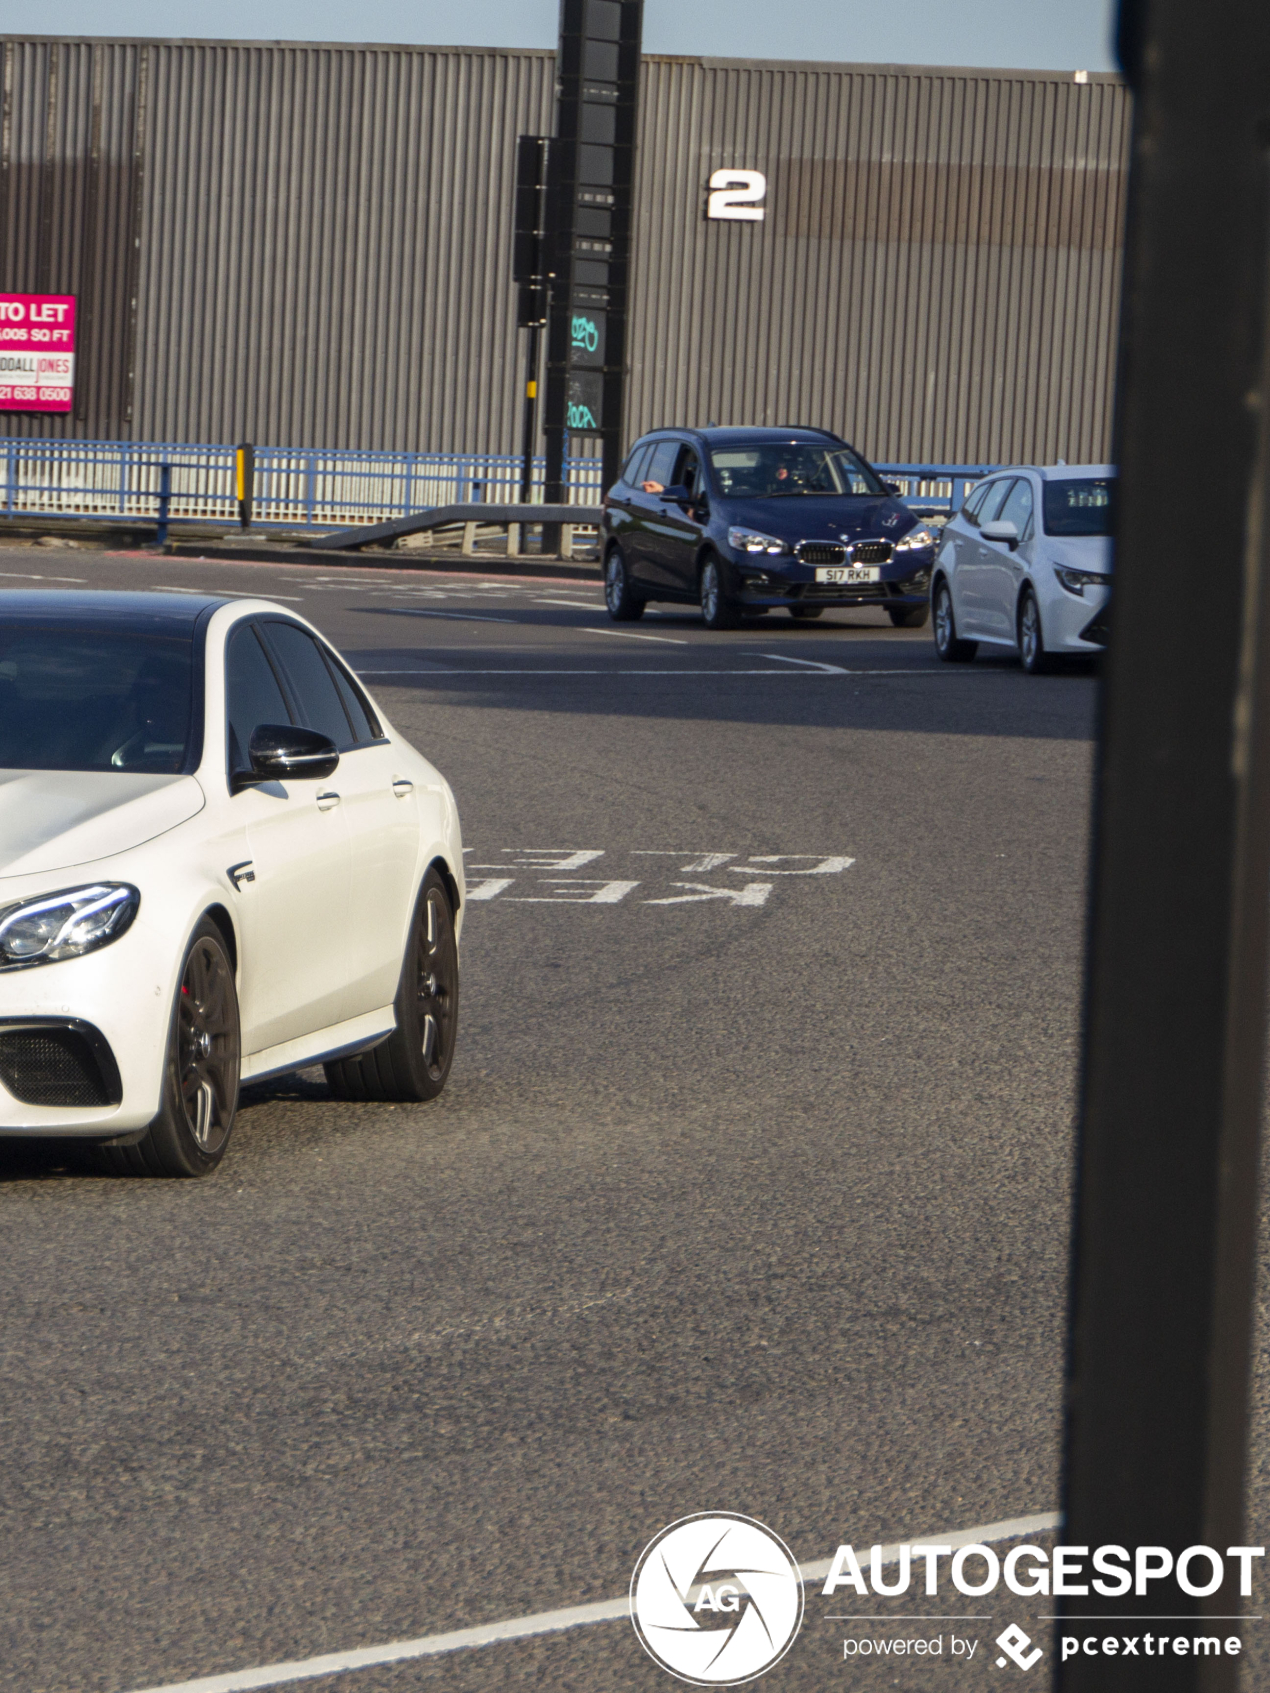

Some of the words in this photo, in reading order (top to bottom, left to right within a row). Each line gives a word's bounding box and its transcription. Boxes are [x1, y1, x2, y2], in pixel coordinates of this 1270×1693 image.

[708, 168, 766, 221] 2
[30, 303, 69, 322] LET
[30, 328, 51, 342] SQ
[52, 329, 71, 342] FT
[39, 387, 71, 401] 0500
[826, 570, 844, 580] S17
[847, 570, 870, 580] RKH
